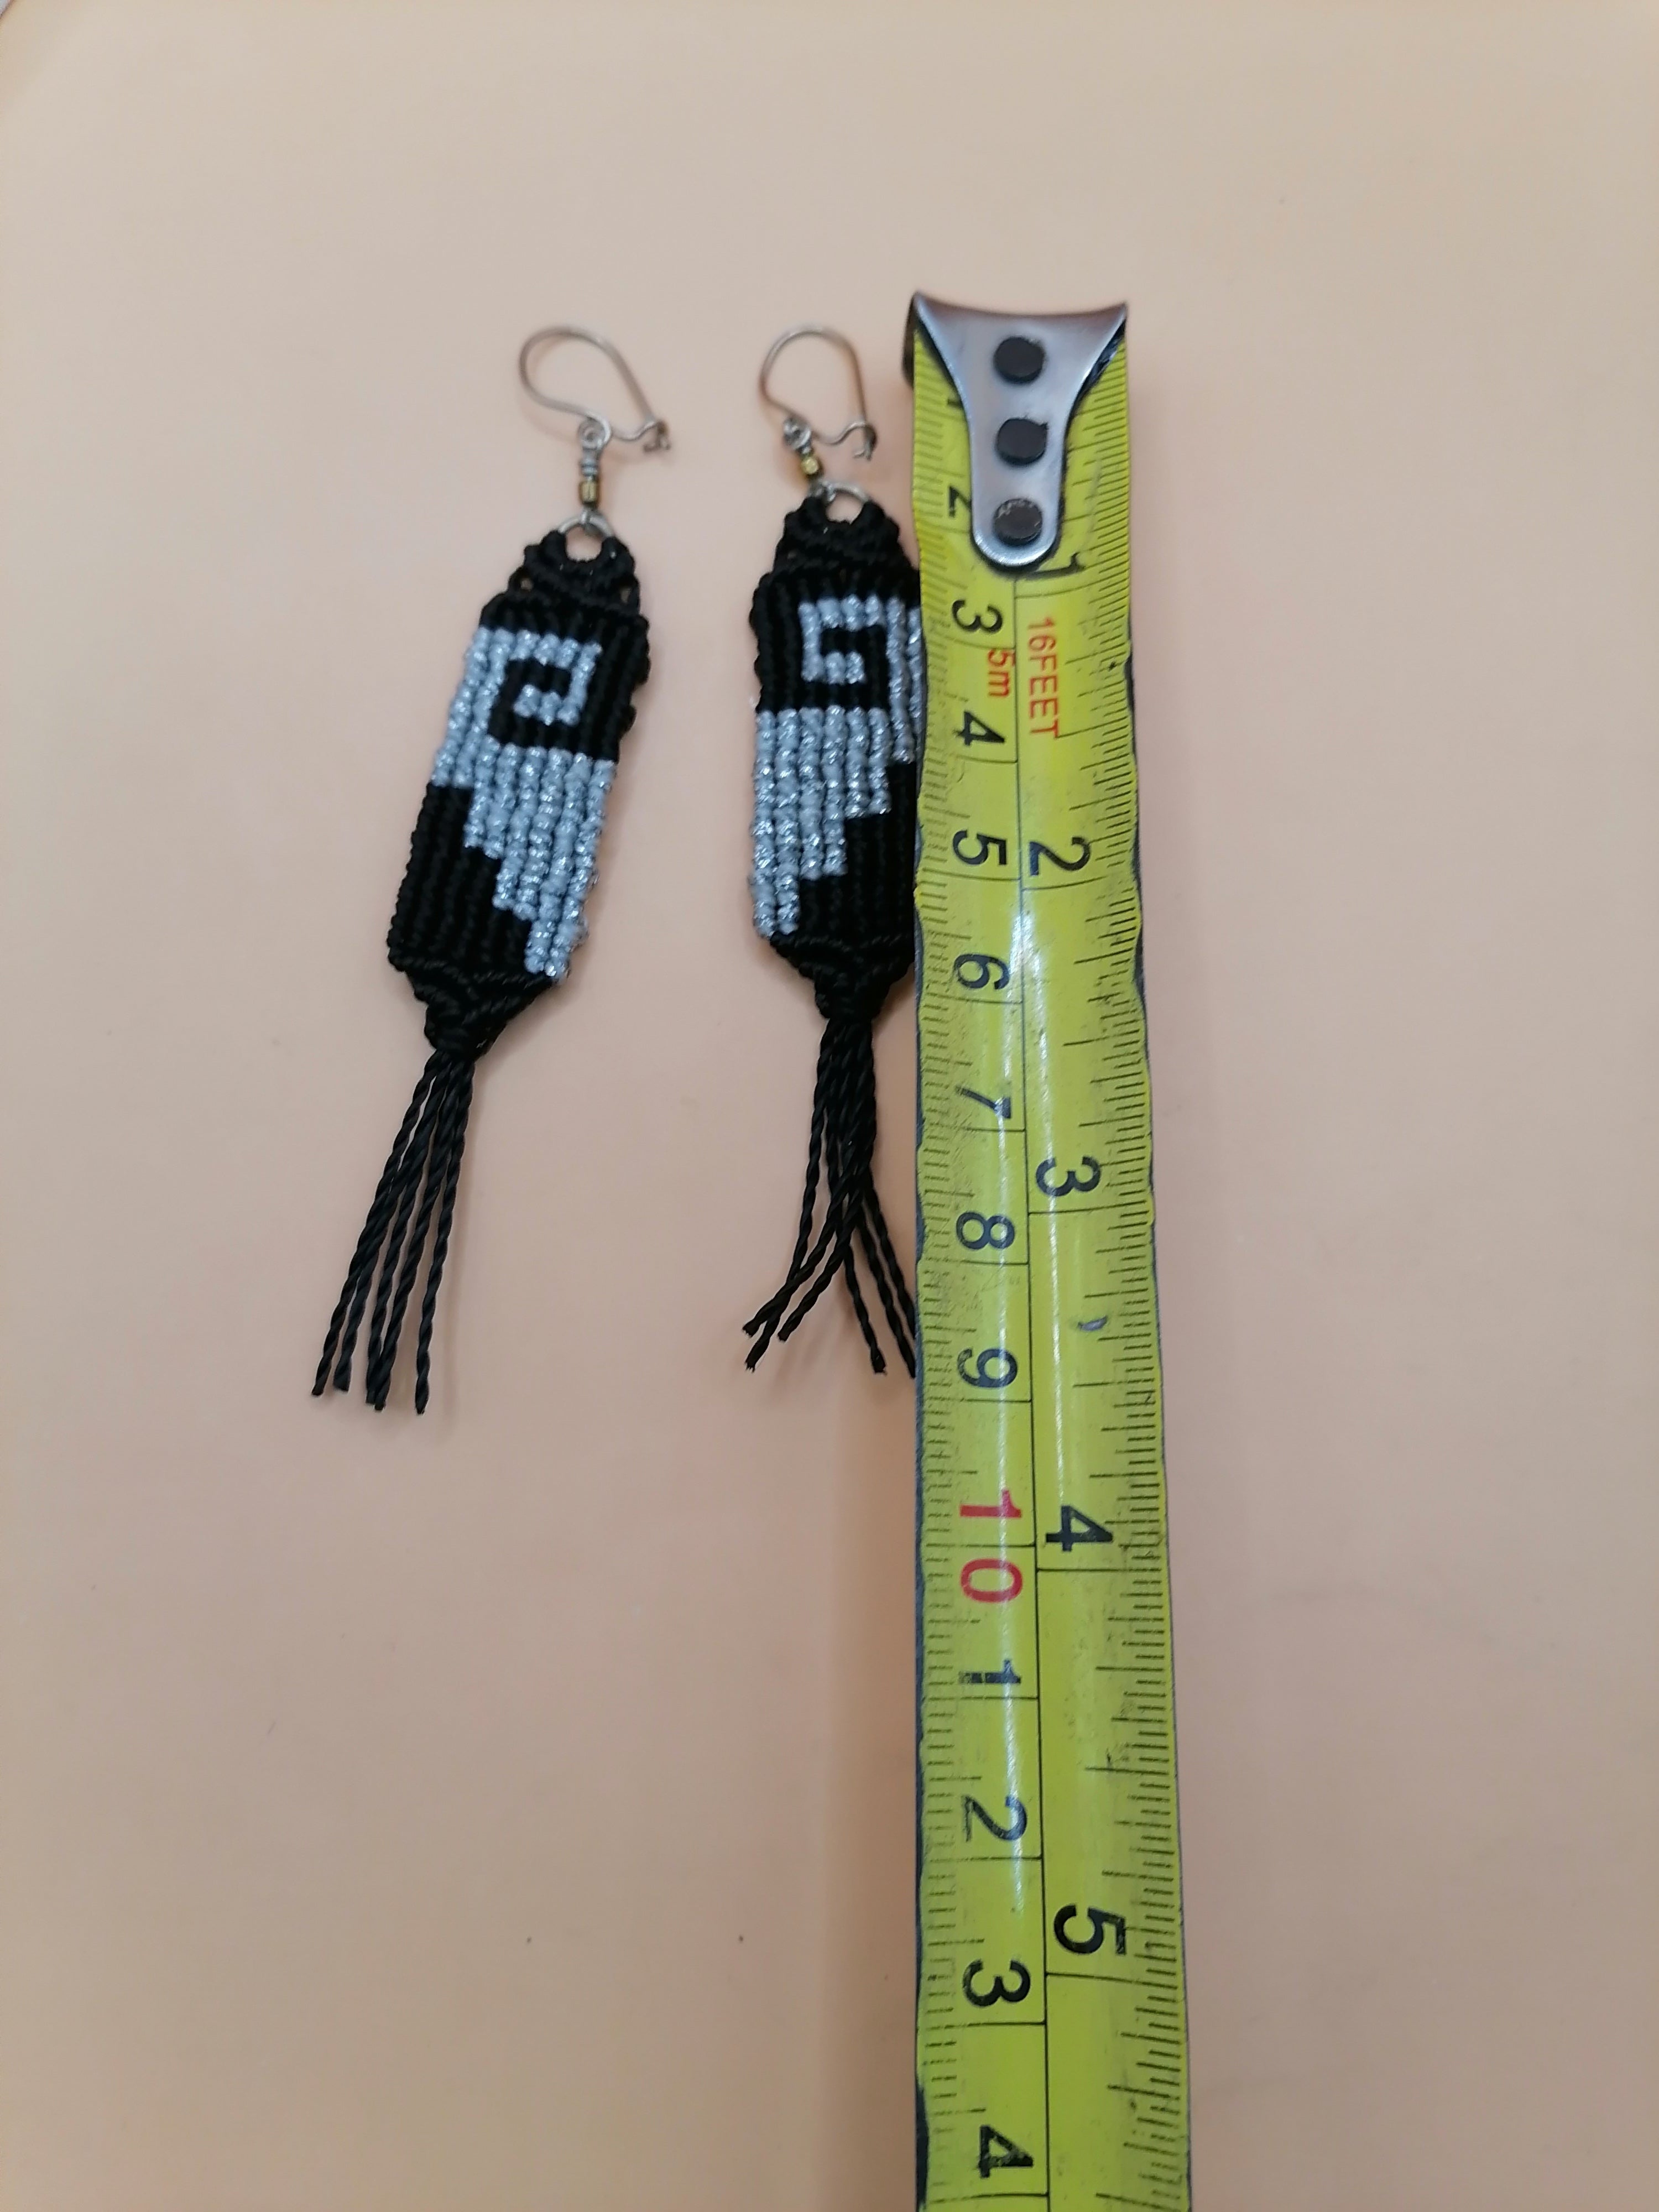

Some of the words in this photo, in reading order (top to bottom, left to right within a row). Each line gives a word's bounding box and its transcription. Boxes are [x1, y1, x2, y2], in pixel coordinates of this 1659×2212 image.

[952, 599, 1003, 634] 3
[988, 649, 1015, 698] 5m
[1027, 617, 1059, 739] 16FEET
[952, 711, 1005, 746] 4
[952, 830, 1006, 866] 5
[1029, 837, 1091, 877] 2
[954, 953, 1009, 989] 6
[956, 1082, 1011, 1119] 7
[1036, 1156, 1101, 1197] 3
[956, 1212, 1015, 1250] 8
[957, 1348, 1018, 1389] 9
[1045, 1505, 1113, 1552] 4
[958, 1660, 1021, 1684] 1
[962, 1795, 1027, 1842] 2
[1053, 1905, 1126, 1955] 5
[963, 1960, 1031, 2007] 3
[977, 2125, 1034, 2178] 4
